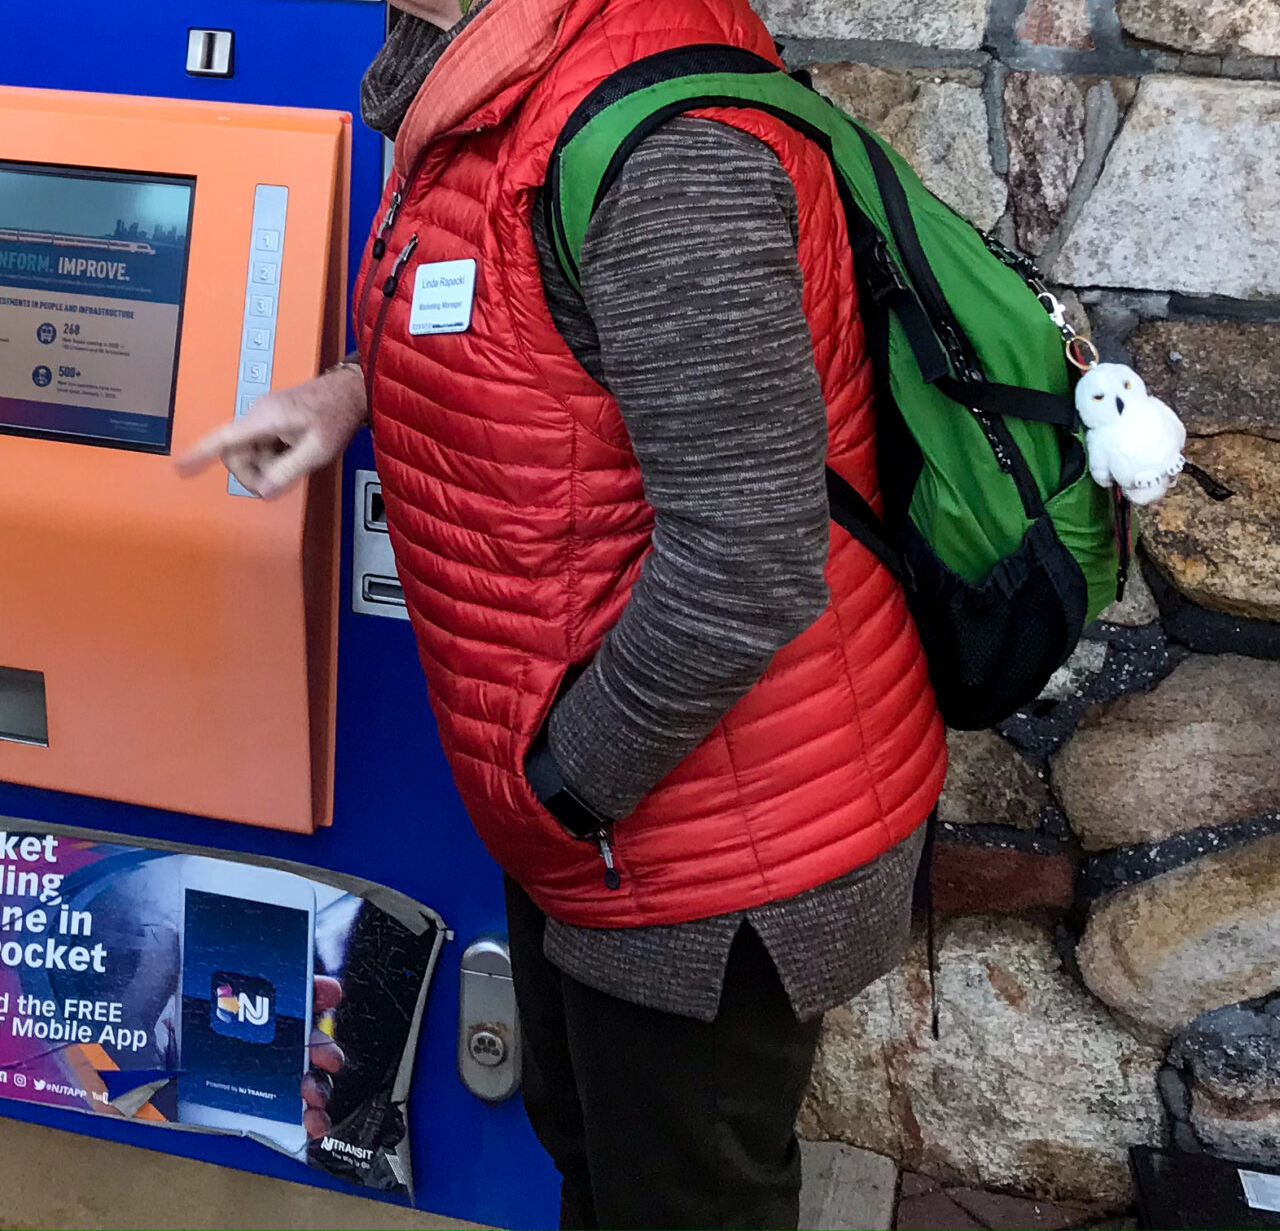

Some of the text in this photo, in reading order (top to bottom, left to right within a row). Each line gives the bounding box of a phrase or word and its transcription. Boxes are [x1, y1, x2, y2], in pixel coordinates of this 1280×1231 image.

[58, 256, 130, 281] IMPROVE.
[422, 278, 439, 289] Linda
[39, 301, 64, 311] PEOPLE
[64, 304, 78, 314] AND
[78, 305, 134, 320] INFRASTRUCTURE
[442, 301, 462, 310] Manager
[58, 366, 81, 378] 500+
[58, 903, 93, 937] in
[17, 994, 56, 1017] the
[64, 998, 122, 1023] FREE
[12, 1018, 92, 1044] Mobile
[98, 1025, 148, 1052] App
